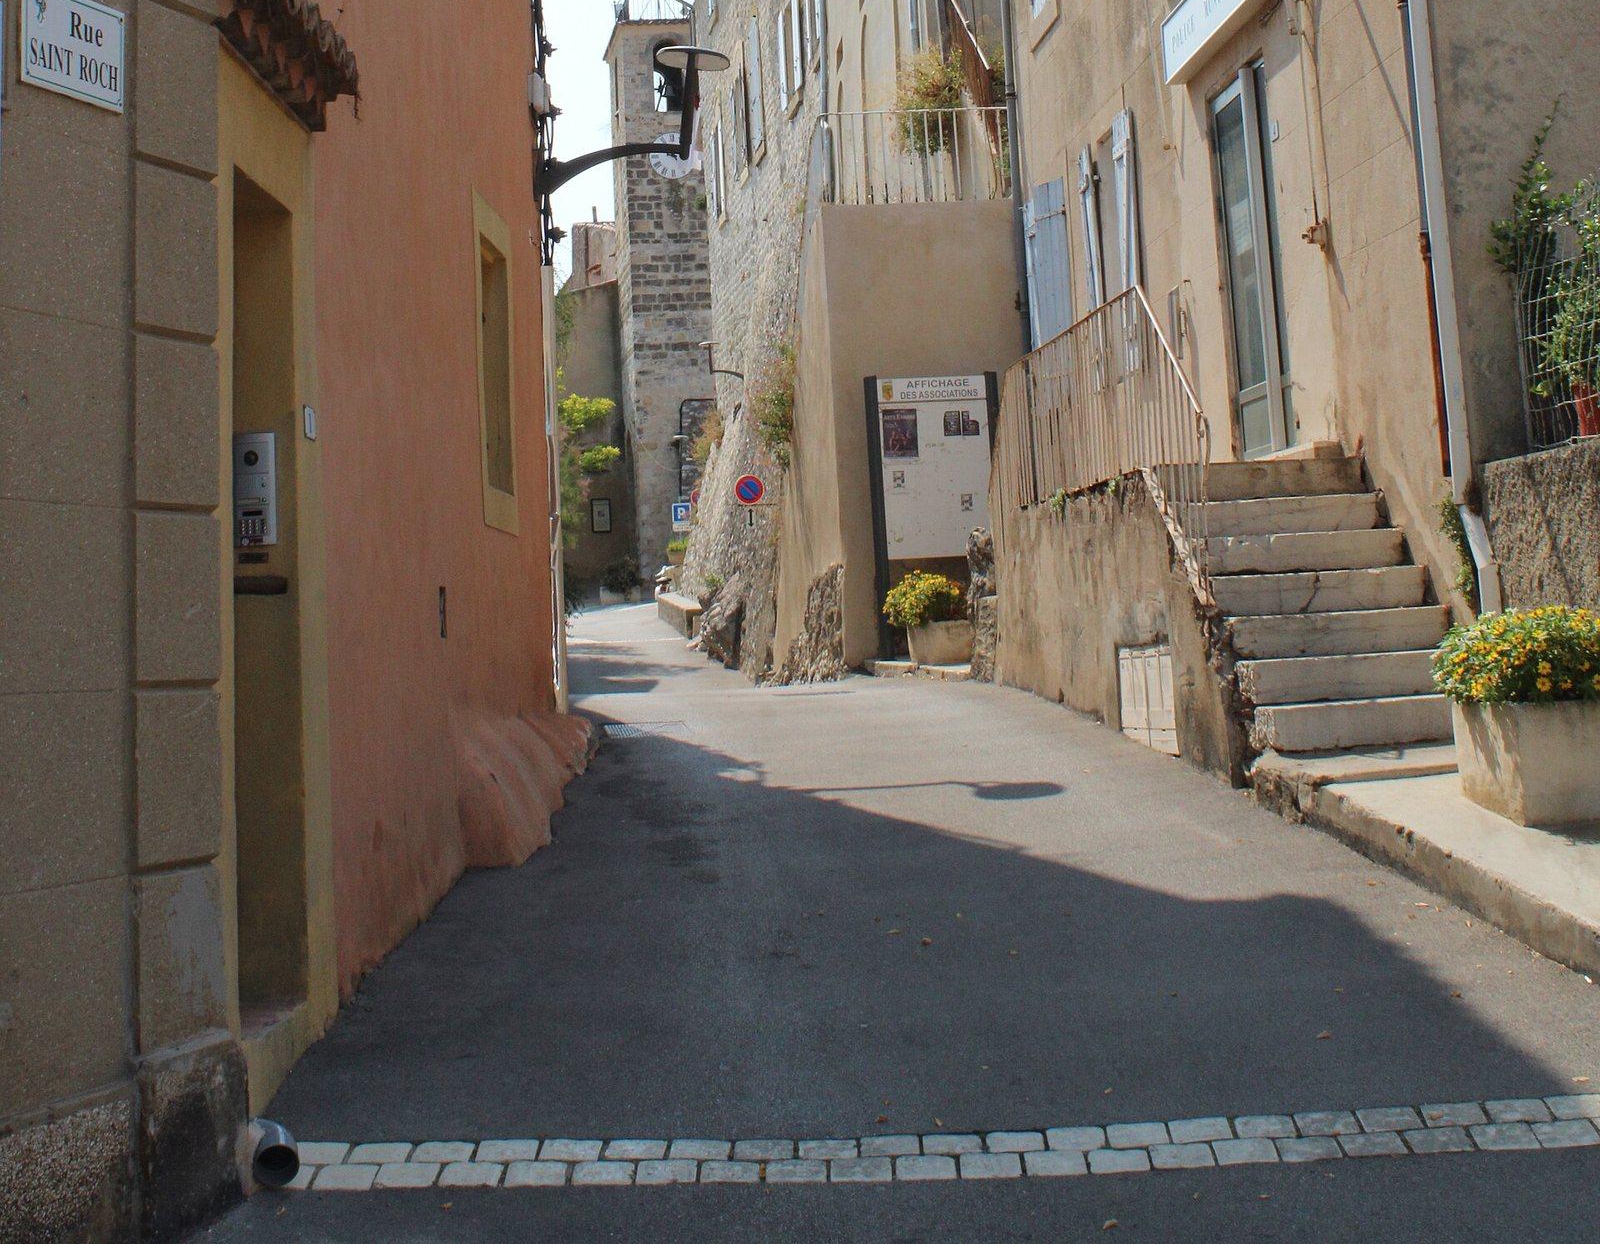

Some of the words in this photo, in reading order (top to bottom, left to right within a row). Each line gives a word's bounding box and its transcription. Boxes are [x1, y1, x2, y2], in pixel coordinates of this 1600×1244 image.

[70, 11, 103, 47] Rue
[1171, 13, 1195, 53] POLICE
[30, 37, 73, 76] SAINT
[79, 54, 118, 92] ROCH
[900, 391, 917, 400] DES
[919, 389, 978, 399] ASSOCIATIONS
[907, 379, 969, 389] AFFICHAGE
[677, 507, 686, 519] P
